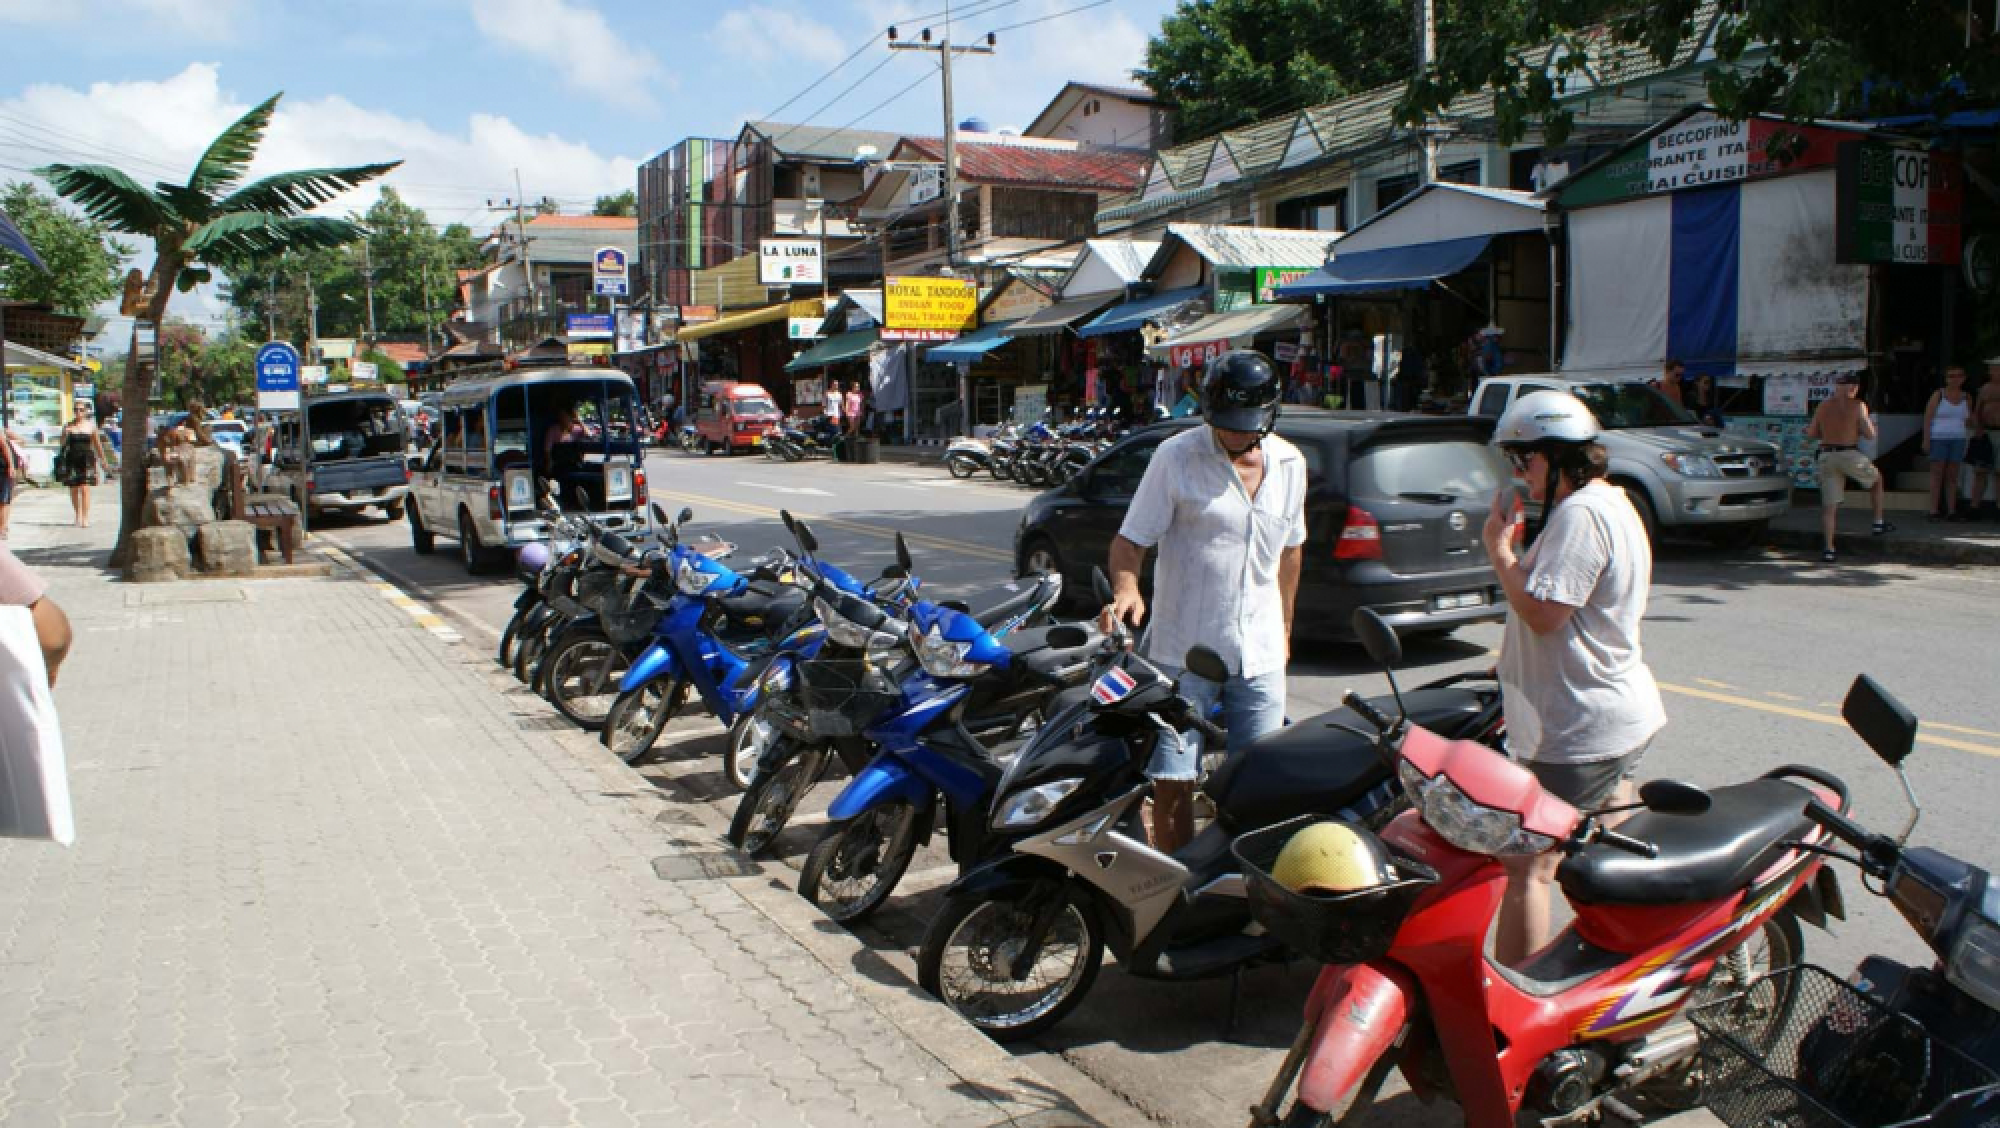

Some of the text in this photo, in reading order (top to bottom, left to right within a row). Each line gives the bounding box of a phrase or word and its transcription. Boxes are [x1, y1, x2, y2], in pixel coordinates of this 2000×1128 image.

[1658, 123, 1741, 150] BECCOFINO
[1626, 161, 1777, 195] THAI CUISINE
[763, 246, 818, 257] LA LUNA
[887, 285, 975, 299] ROYAL TANDOOR
[898, 299, 965, 311] INDIAN FOOD
